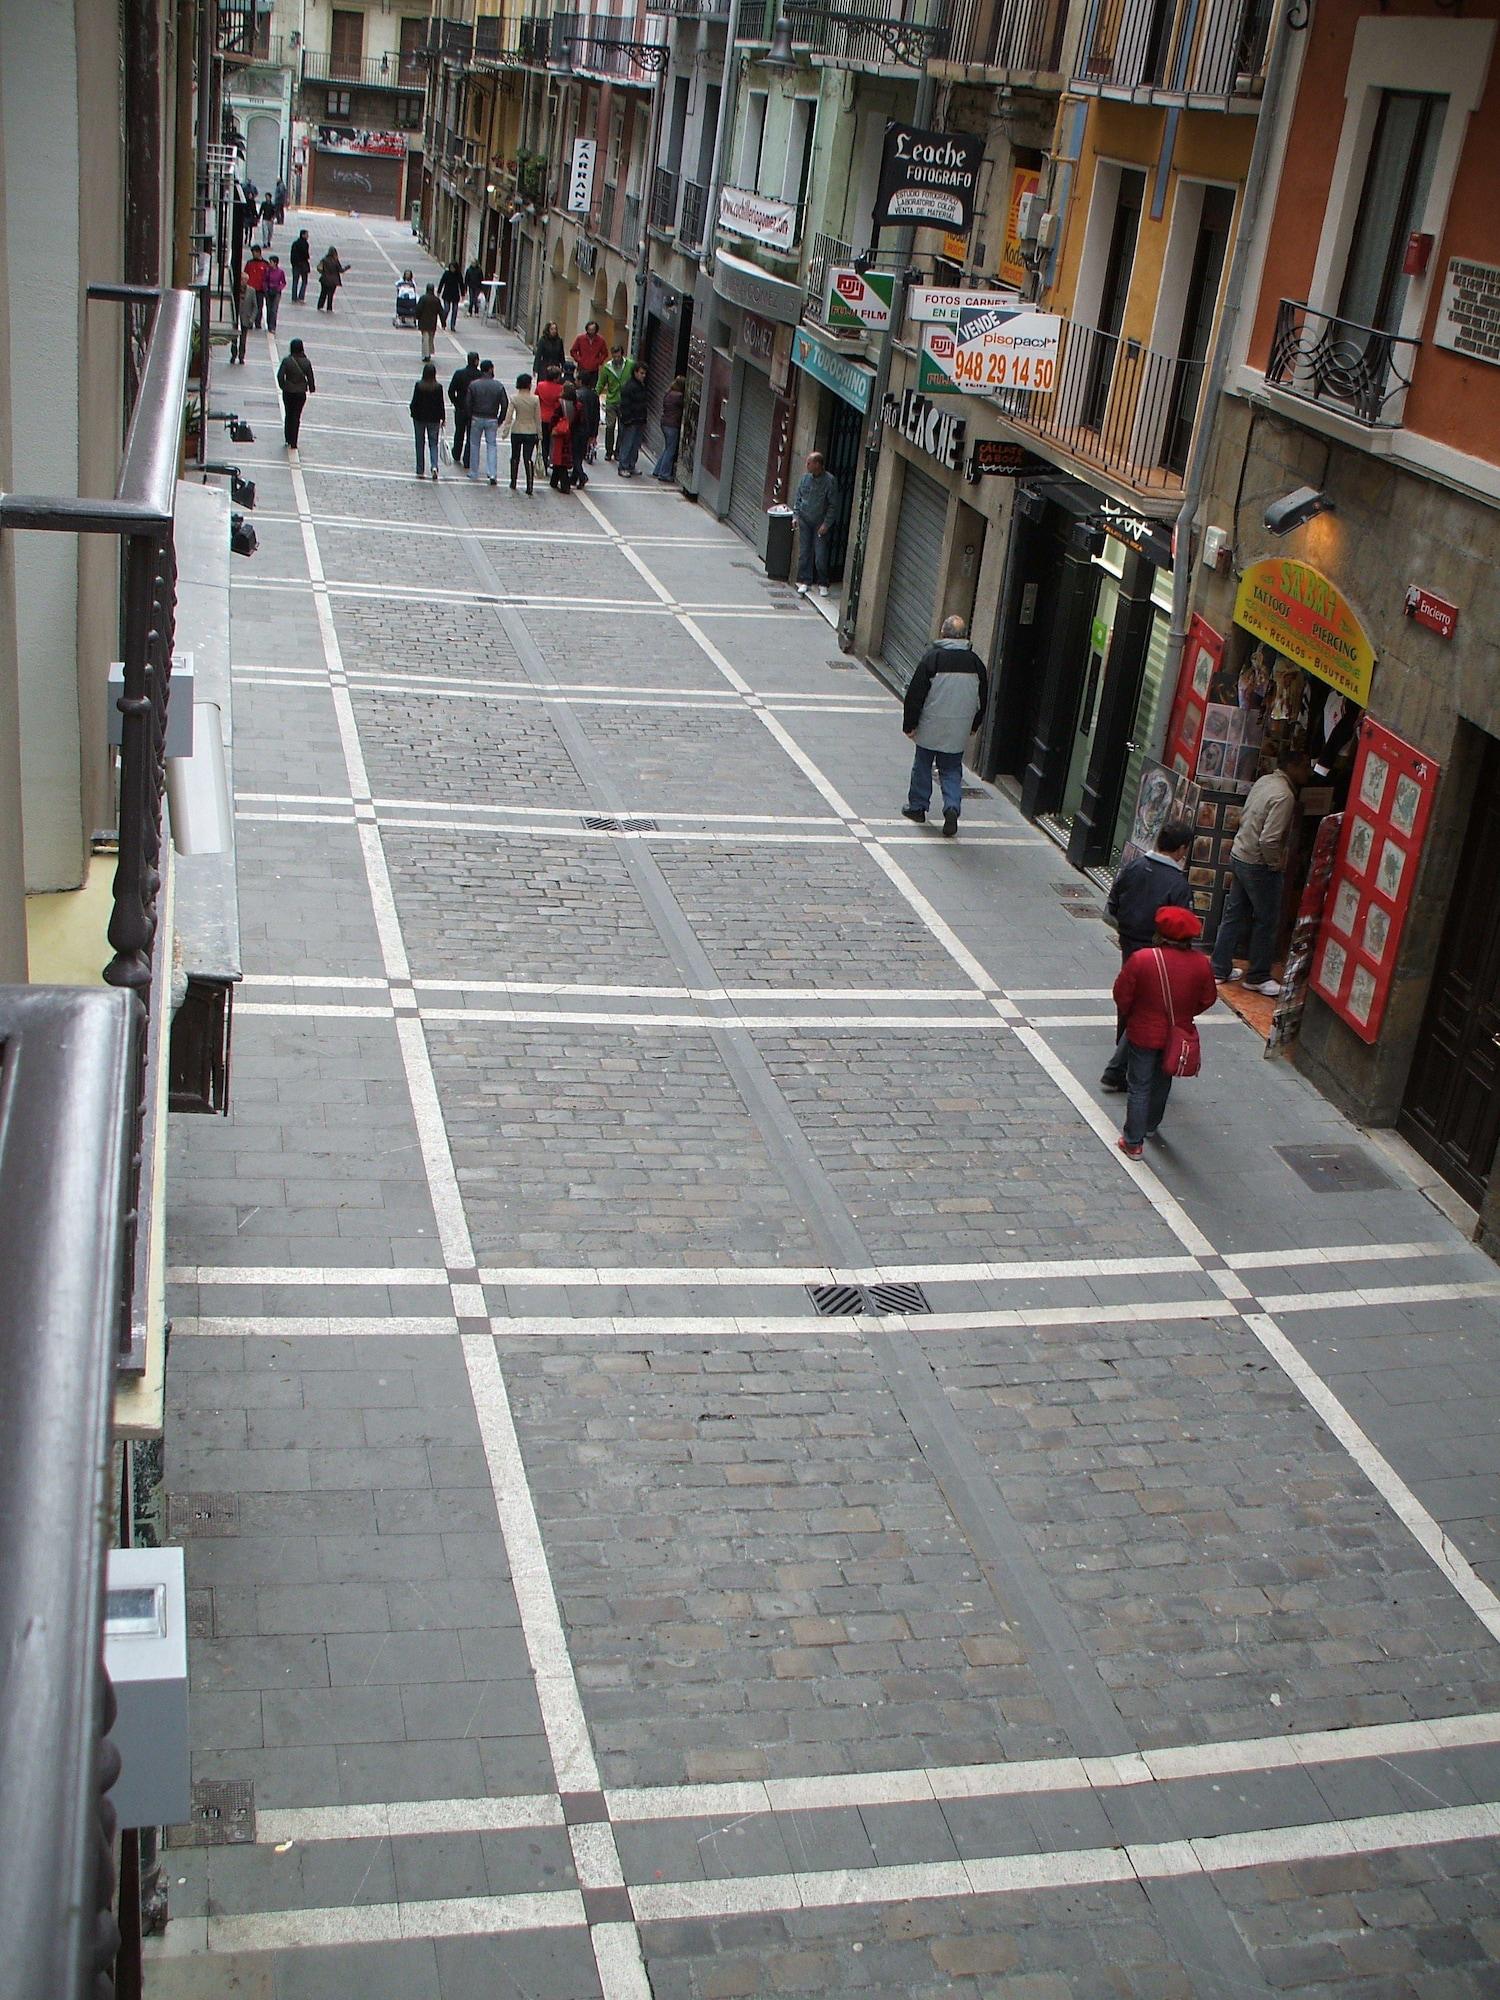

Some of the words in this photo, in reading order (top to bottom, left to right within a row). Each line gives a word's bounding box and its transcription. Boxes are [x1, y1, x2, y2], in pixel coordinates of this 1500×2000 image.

[894, 133, 967, 168] Leache
[575, 142, 591, 208] ZARRANZ
[906, 165, 972, 188] FOTOGRAFO
[895, 206, 914, 215] VENTA
[927, 208, 955, 220] MATERIAL
[832, 305, 858, 317] FUJI
[861, 309, 887, 320] FILM
[925, 294, 961, 305] FOTOS
[932, 308, 946, 318] EN
[959, 310, 1000, 341] VENDE
[813, 345, 867, 397] TODOCHINO
[955, 350, 984, 382] 948
[987, 353, 1006, 384] 29
[1012, 356, 1030, 386] 14
[1034, 359, 1053, 389] 50
[899, 389, 957, 471] LEACHE
[994, 454, 1023, 465] BOCA
[1254, 586, 1290, 618] TATTOOS
[1312, 624, 1357, 661] PIERCING
[1420, 600, 1451, 625] Encierro
[1242, 611, 1262, 630] ROPA
[1269, 629, 1306, 659] REGALOS
[1313, 657, 1360, 695] BISUTERIA
